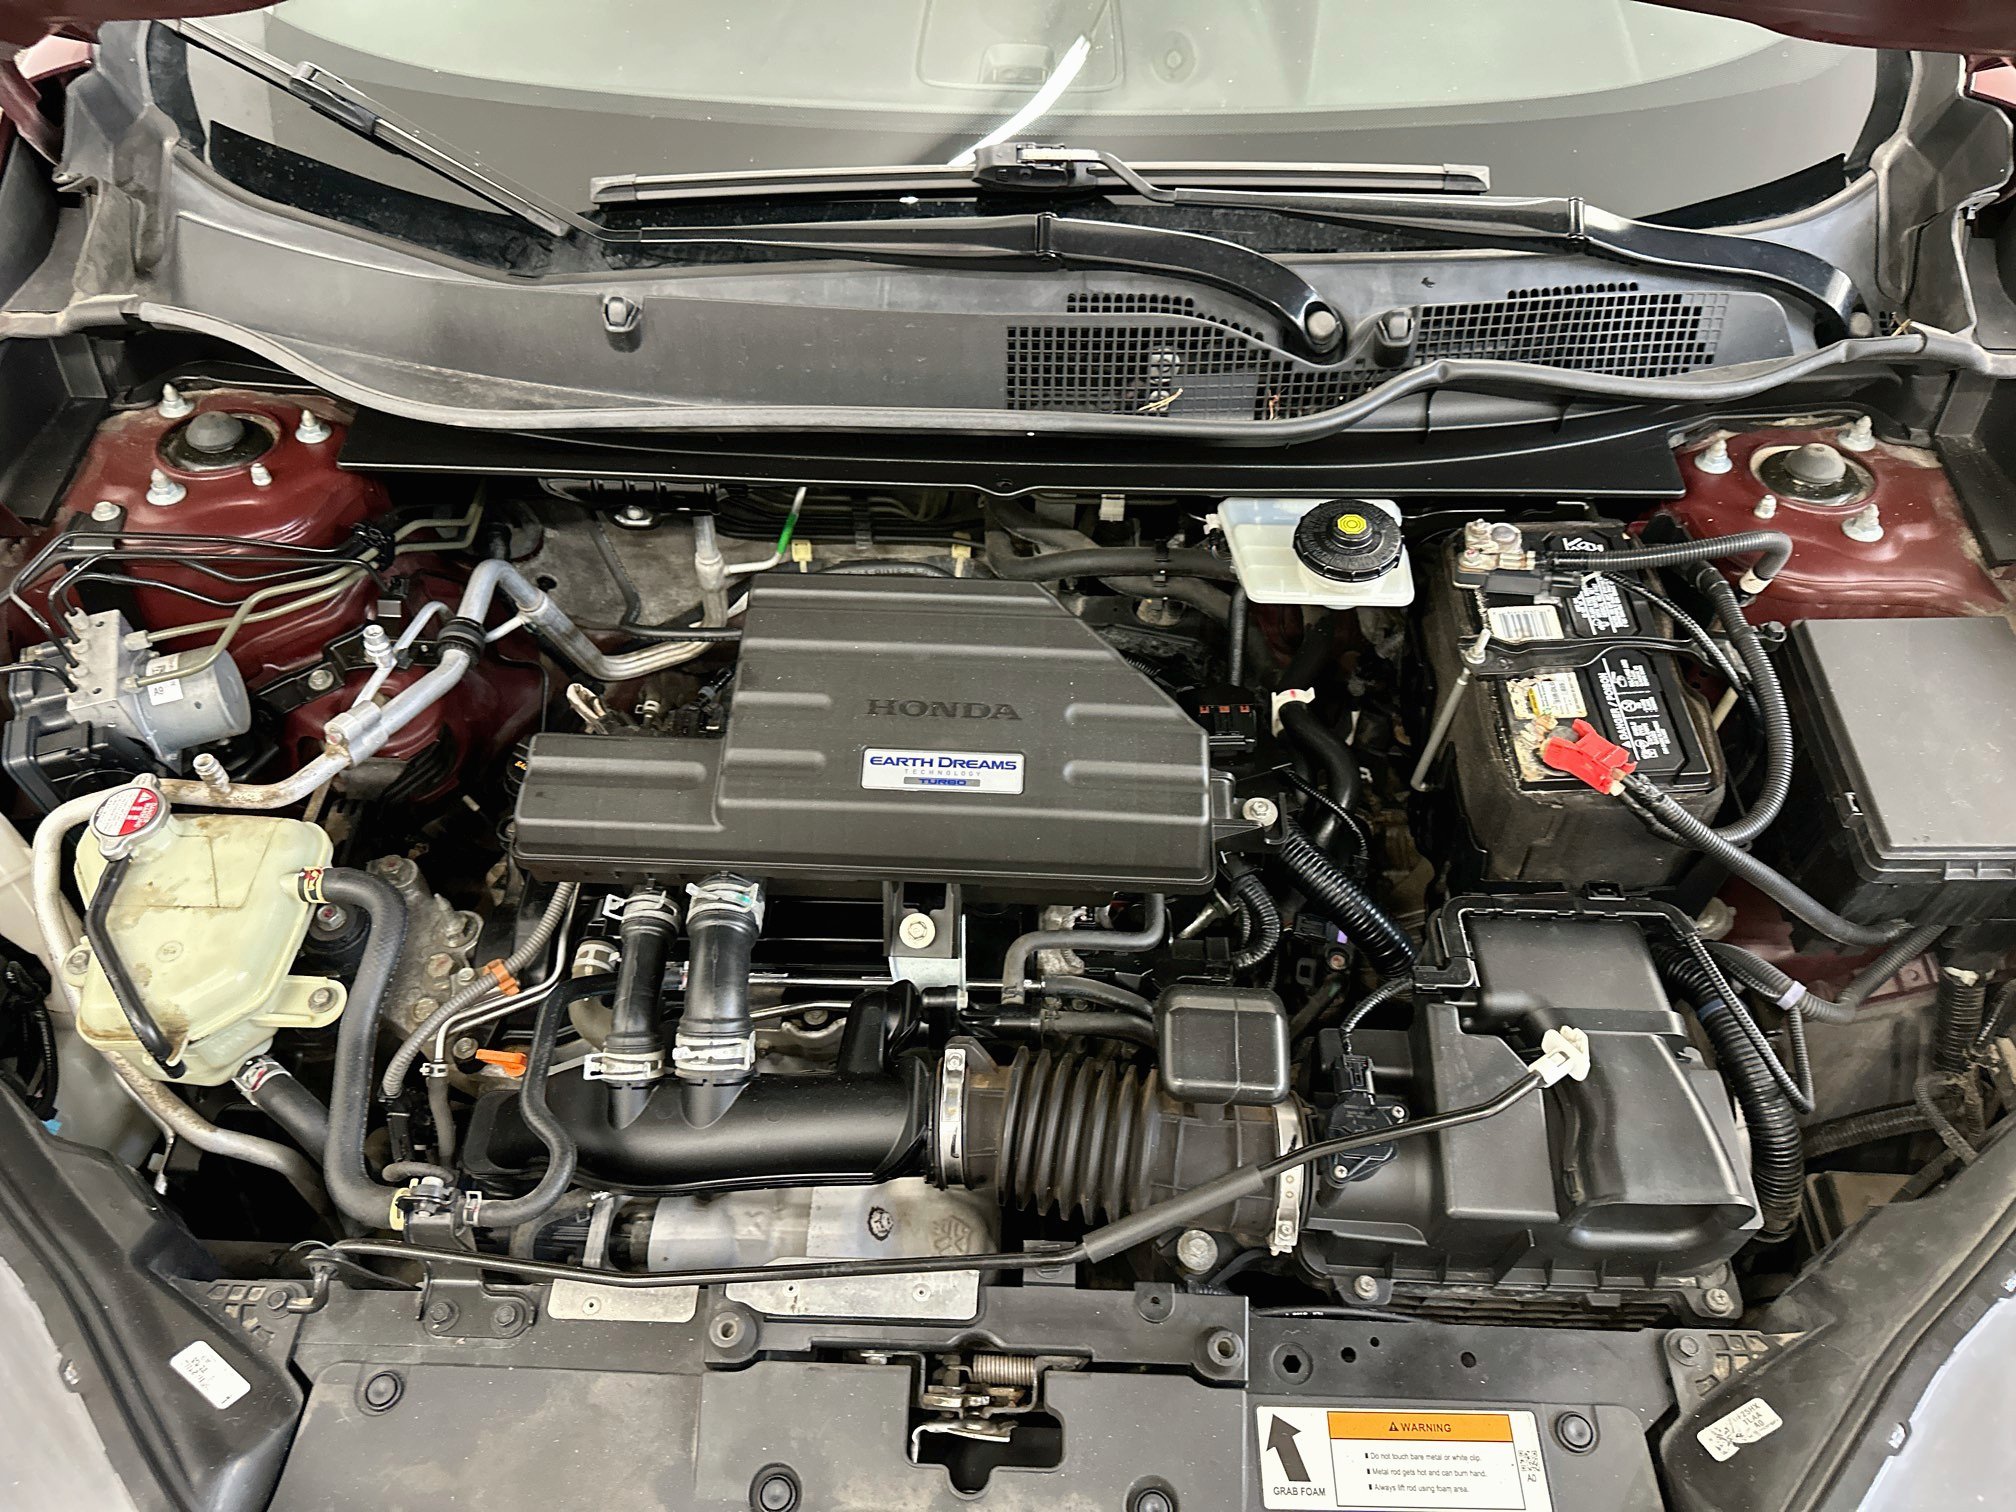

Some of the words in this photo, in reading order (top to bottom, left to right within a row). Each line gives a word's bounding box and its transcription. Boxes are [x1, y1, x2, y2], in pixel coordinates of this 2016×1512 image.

[863, 699, 1022, 721] HONDA
[870, 756, 934, 768] EARTH
[938, 757, 1017, 770] DREAMS
[904, 769, 981, 777] TECHNOLOGY
[918, 777, 967, 786] TURBO
[1400, 1422, 1452, 1433] WARNING
[1370, 1452, 1380, 1460] Do
[1390, 1468, 1401, 1476] rod
[1402, 1469, 1416, 1478] gets
[1428, 1469, 1440, 1477] and
[1272, 1486, 1299, 1496] GRAB
[1300, 1486, 1327, 1497] FOAM
[1374, 1483, 1397, 1493] Always
[1406, 1484, 1417, 1492] rod
[1418, 1486, 1435, 1494] using
[1436, 1484, 1452, 1493] foam
